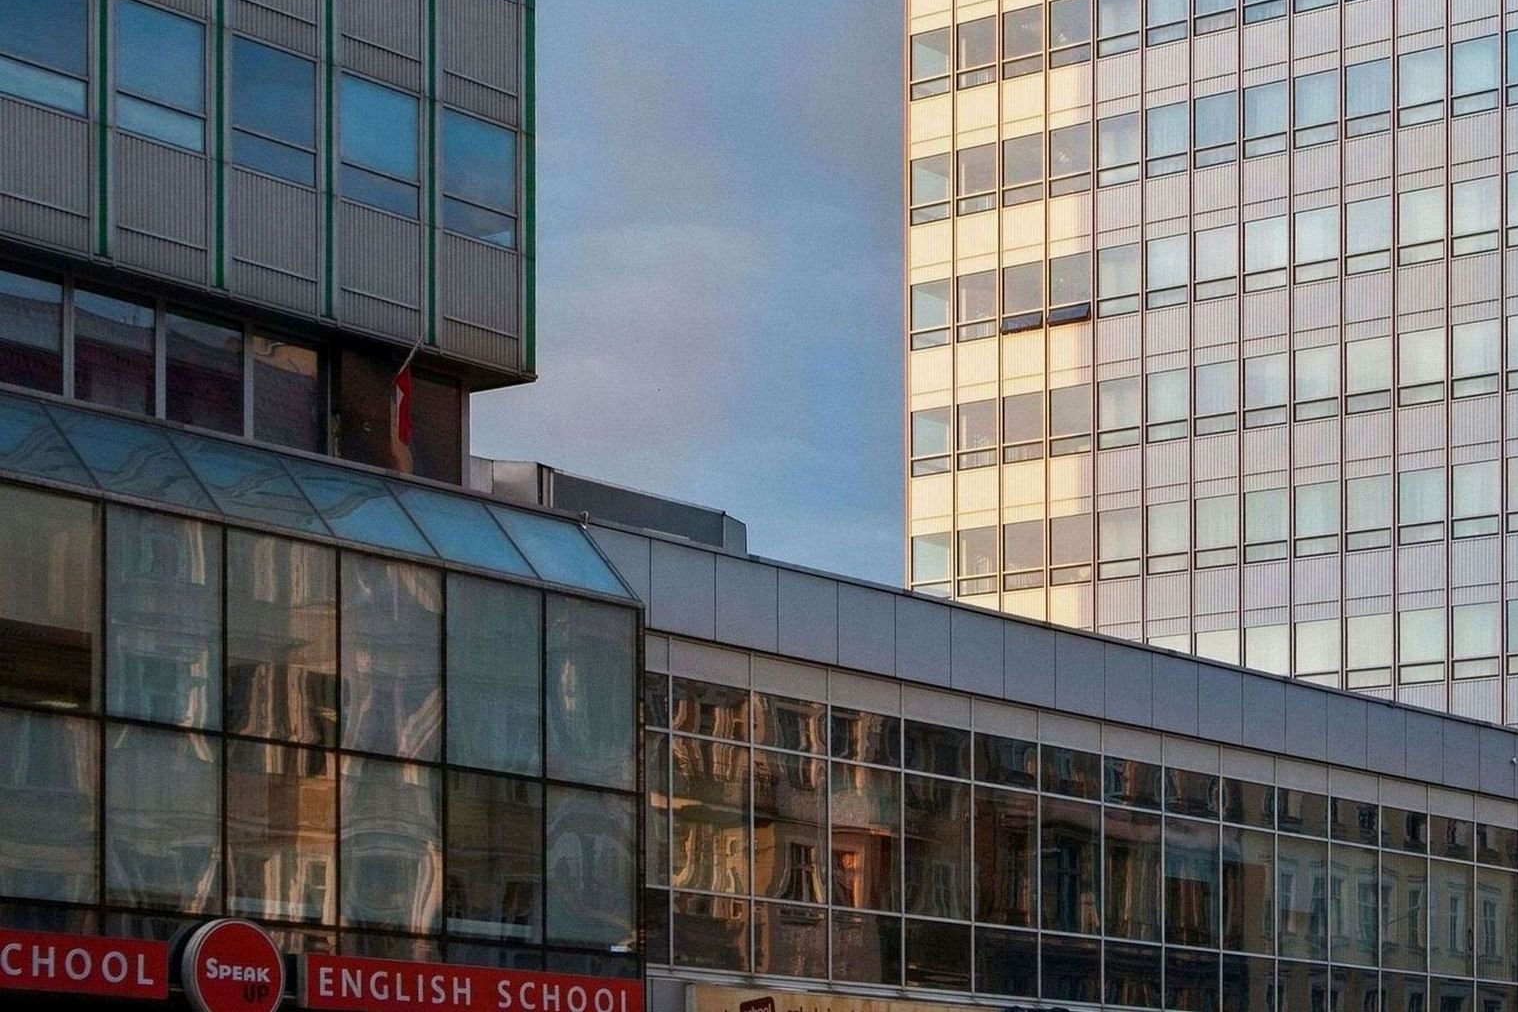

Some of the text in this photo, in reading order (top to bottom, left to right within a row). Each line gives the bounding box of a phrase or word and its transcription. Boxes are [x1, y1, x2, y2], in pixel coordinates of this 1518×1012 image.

[206, 957, 271, 983] SPEAK
[243, 984, 269, 1003] UP
[319, 967, 471, 1005] ENGLISH
